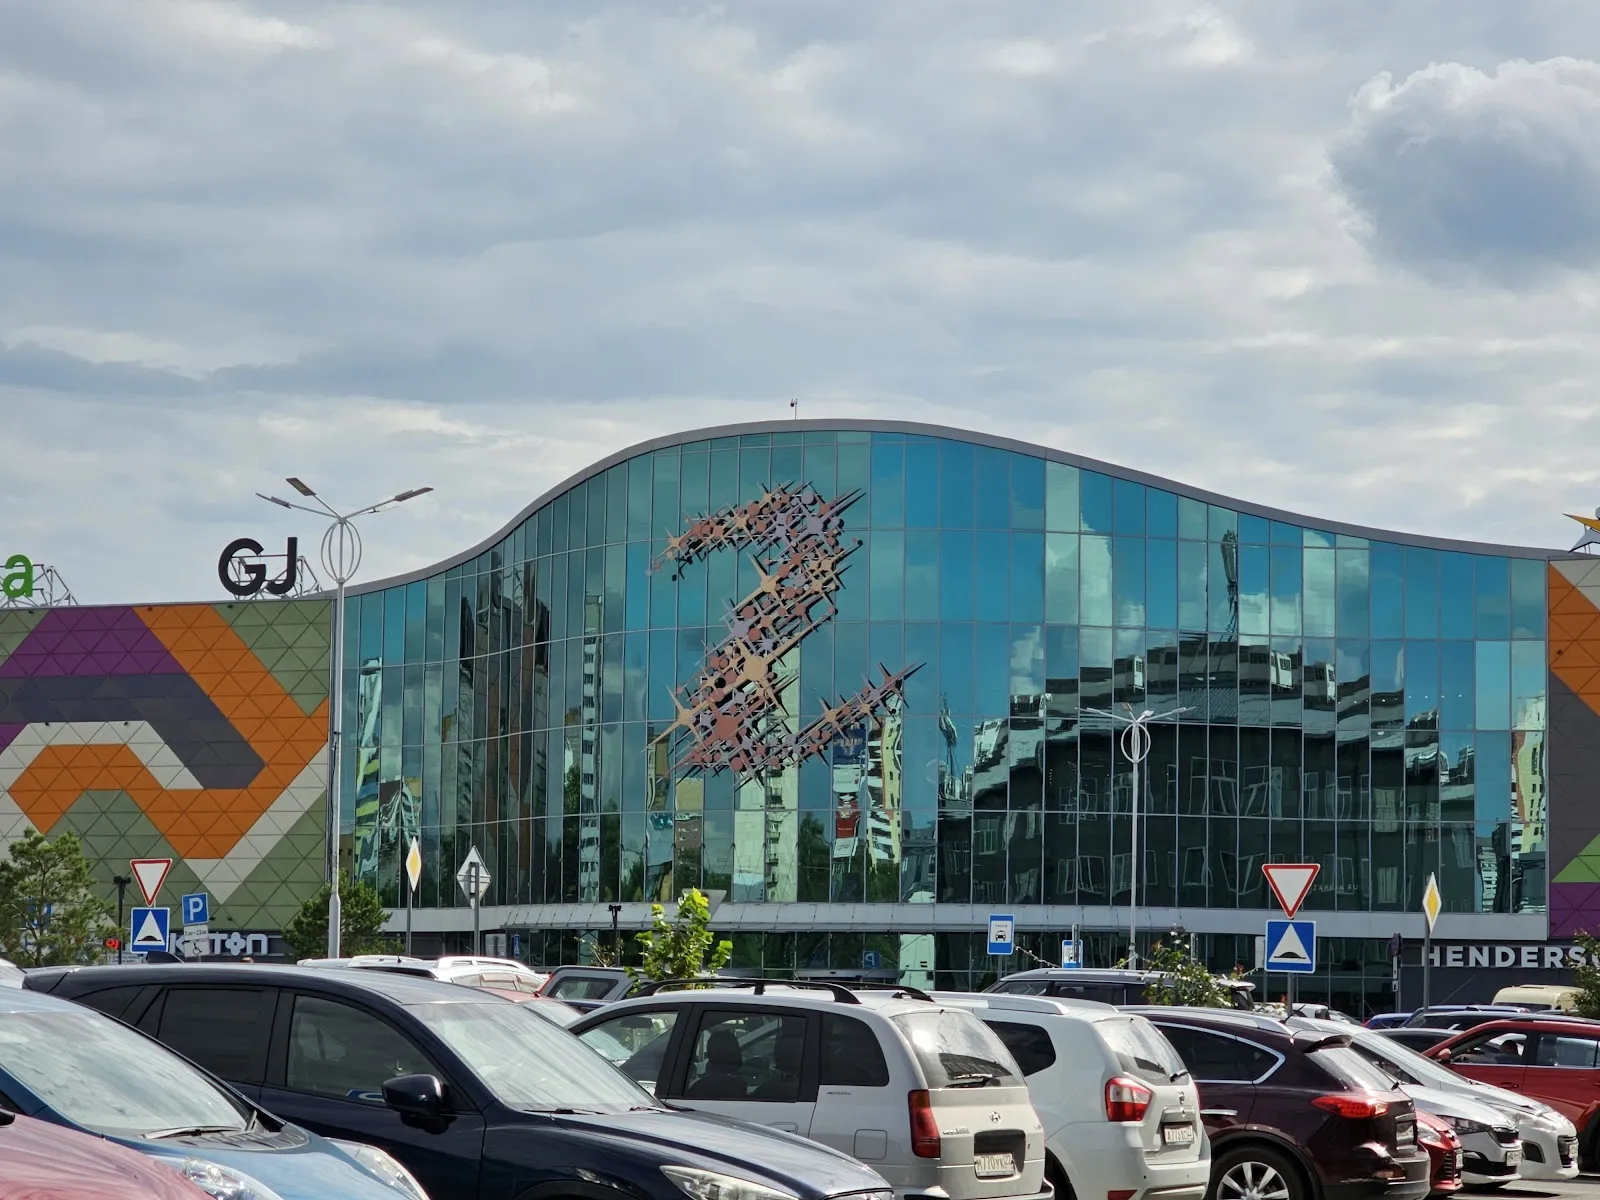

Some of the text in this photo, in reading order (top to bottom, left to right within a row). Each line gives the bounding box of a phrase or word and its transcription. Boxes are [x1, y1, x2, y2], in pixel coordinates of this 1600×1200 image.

[2, 554, 33, 597] a
[218, 536, 298, 596] GJ
[189, 897, 203, 921] P
[1421, 945, 1600, 969] HENDERS
